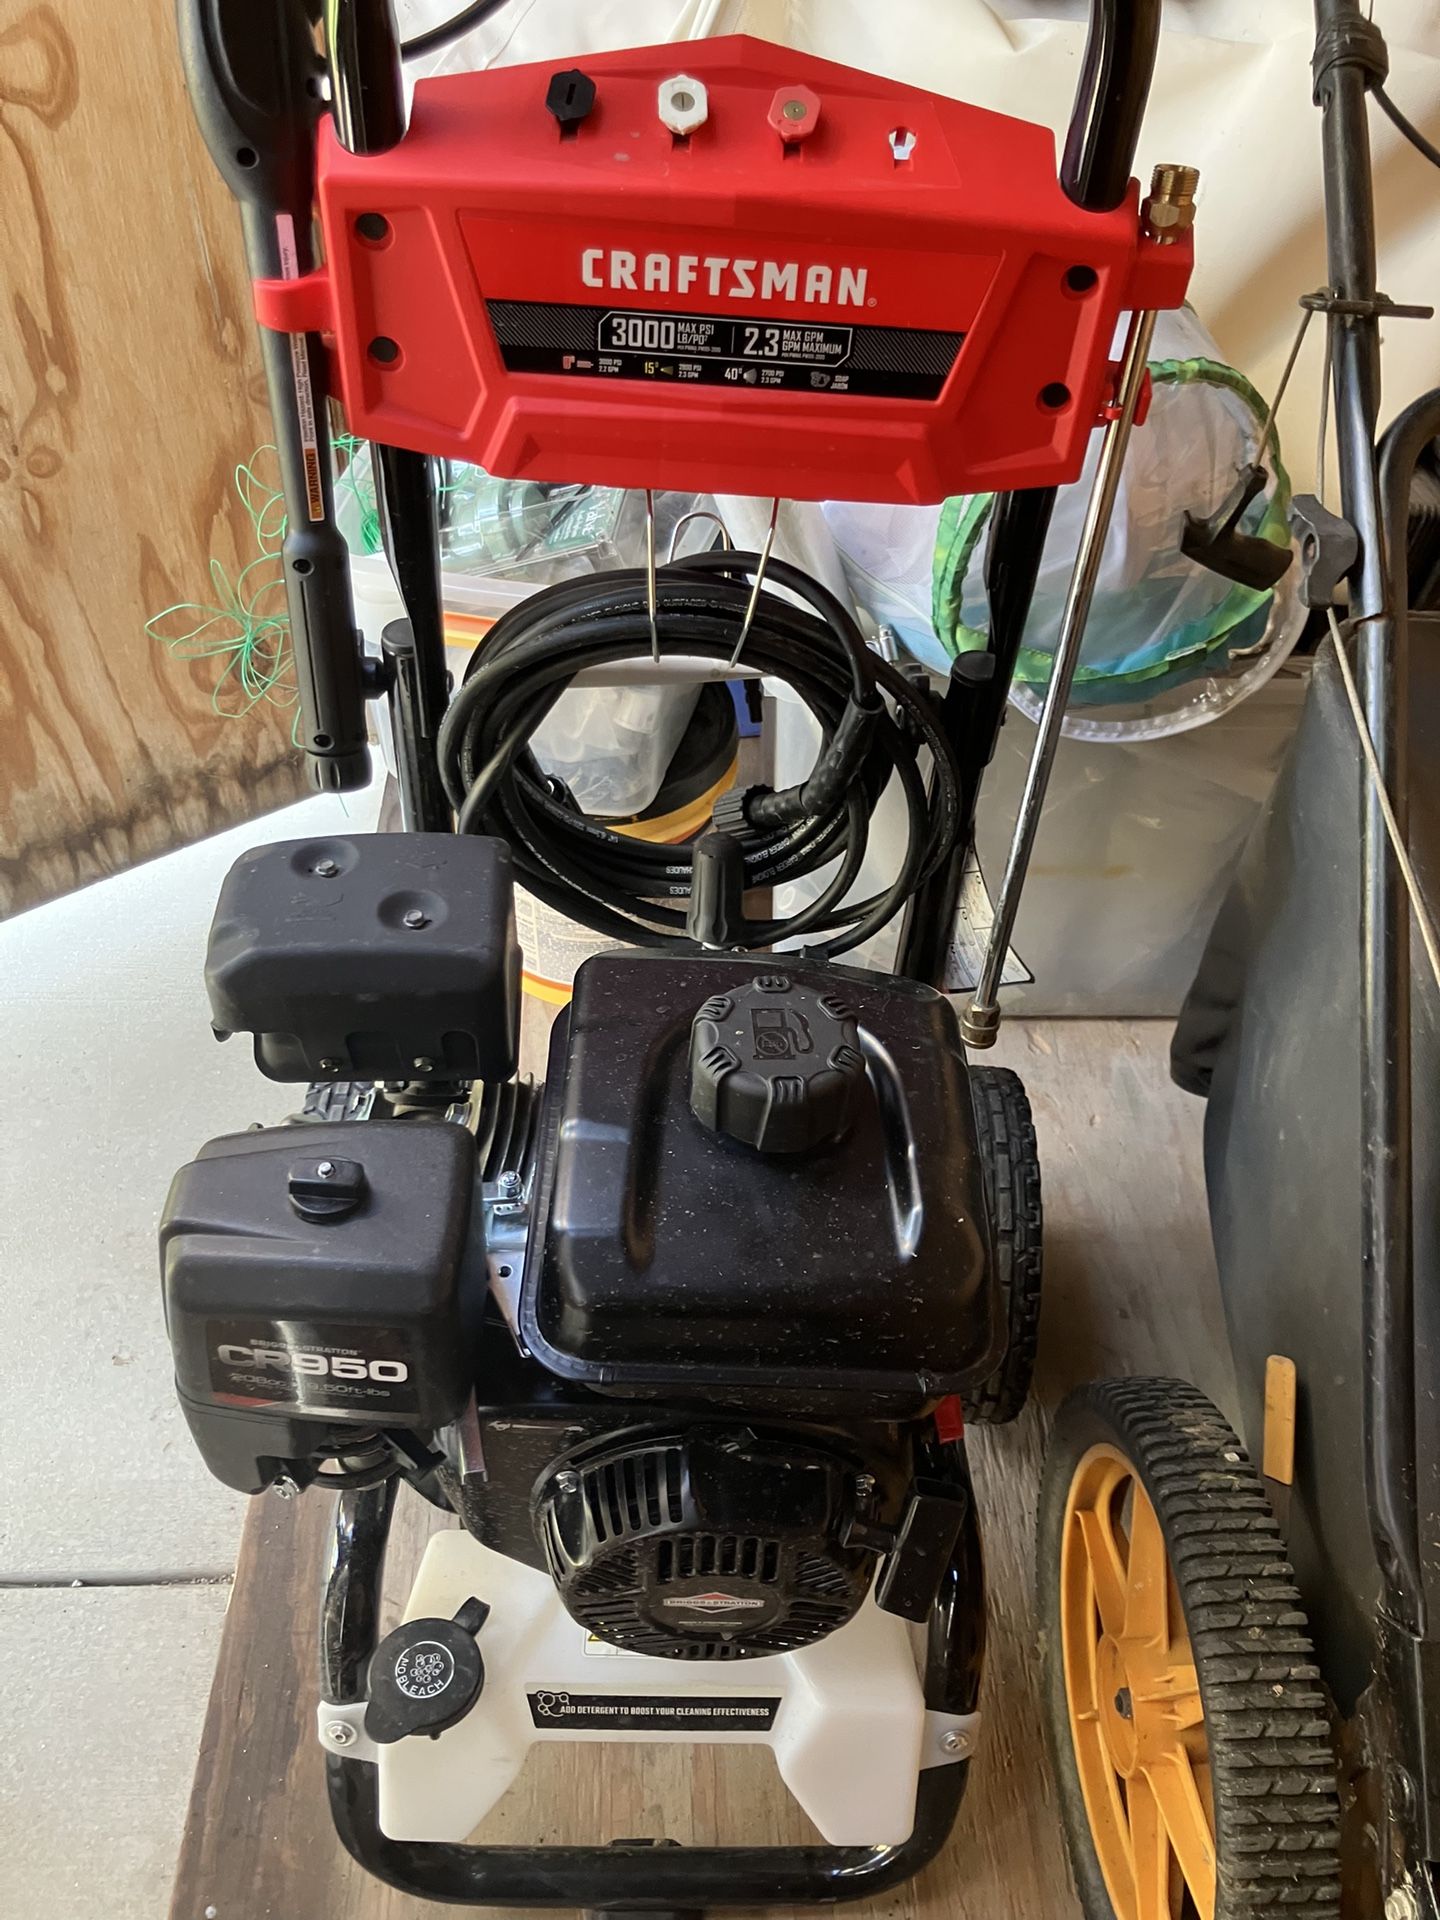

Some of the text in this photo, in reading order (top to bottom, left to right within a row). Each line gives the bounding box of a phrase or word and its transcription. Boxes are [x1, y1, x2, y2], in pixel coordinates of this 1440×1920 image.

[582, 249, 867, 306] CRAFTSMAN
[612, 318, 675, 349] 3000
[677, 322, 714, 335] MAX PSI
[783, 329, 824, 343] MAX GPM
[743, 327, 780, 356] 2.3
[782, 340, 842, 355] GPM MAXIMUM
[304, 452, 319, 503] WARNING
[216, 1344, 408, 1383] CR950
[397, 1658, 409, 1674] NO
[398, 1676, 444, 1695] BLEACH
[560, 1706, 769, 1716] ADD DETERGENT TO BOOST YOUR CLEANING EFFECTIVENESS
